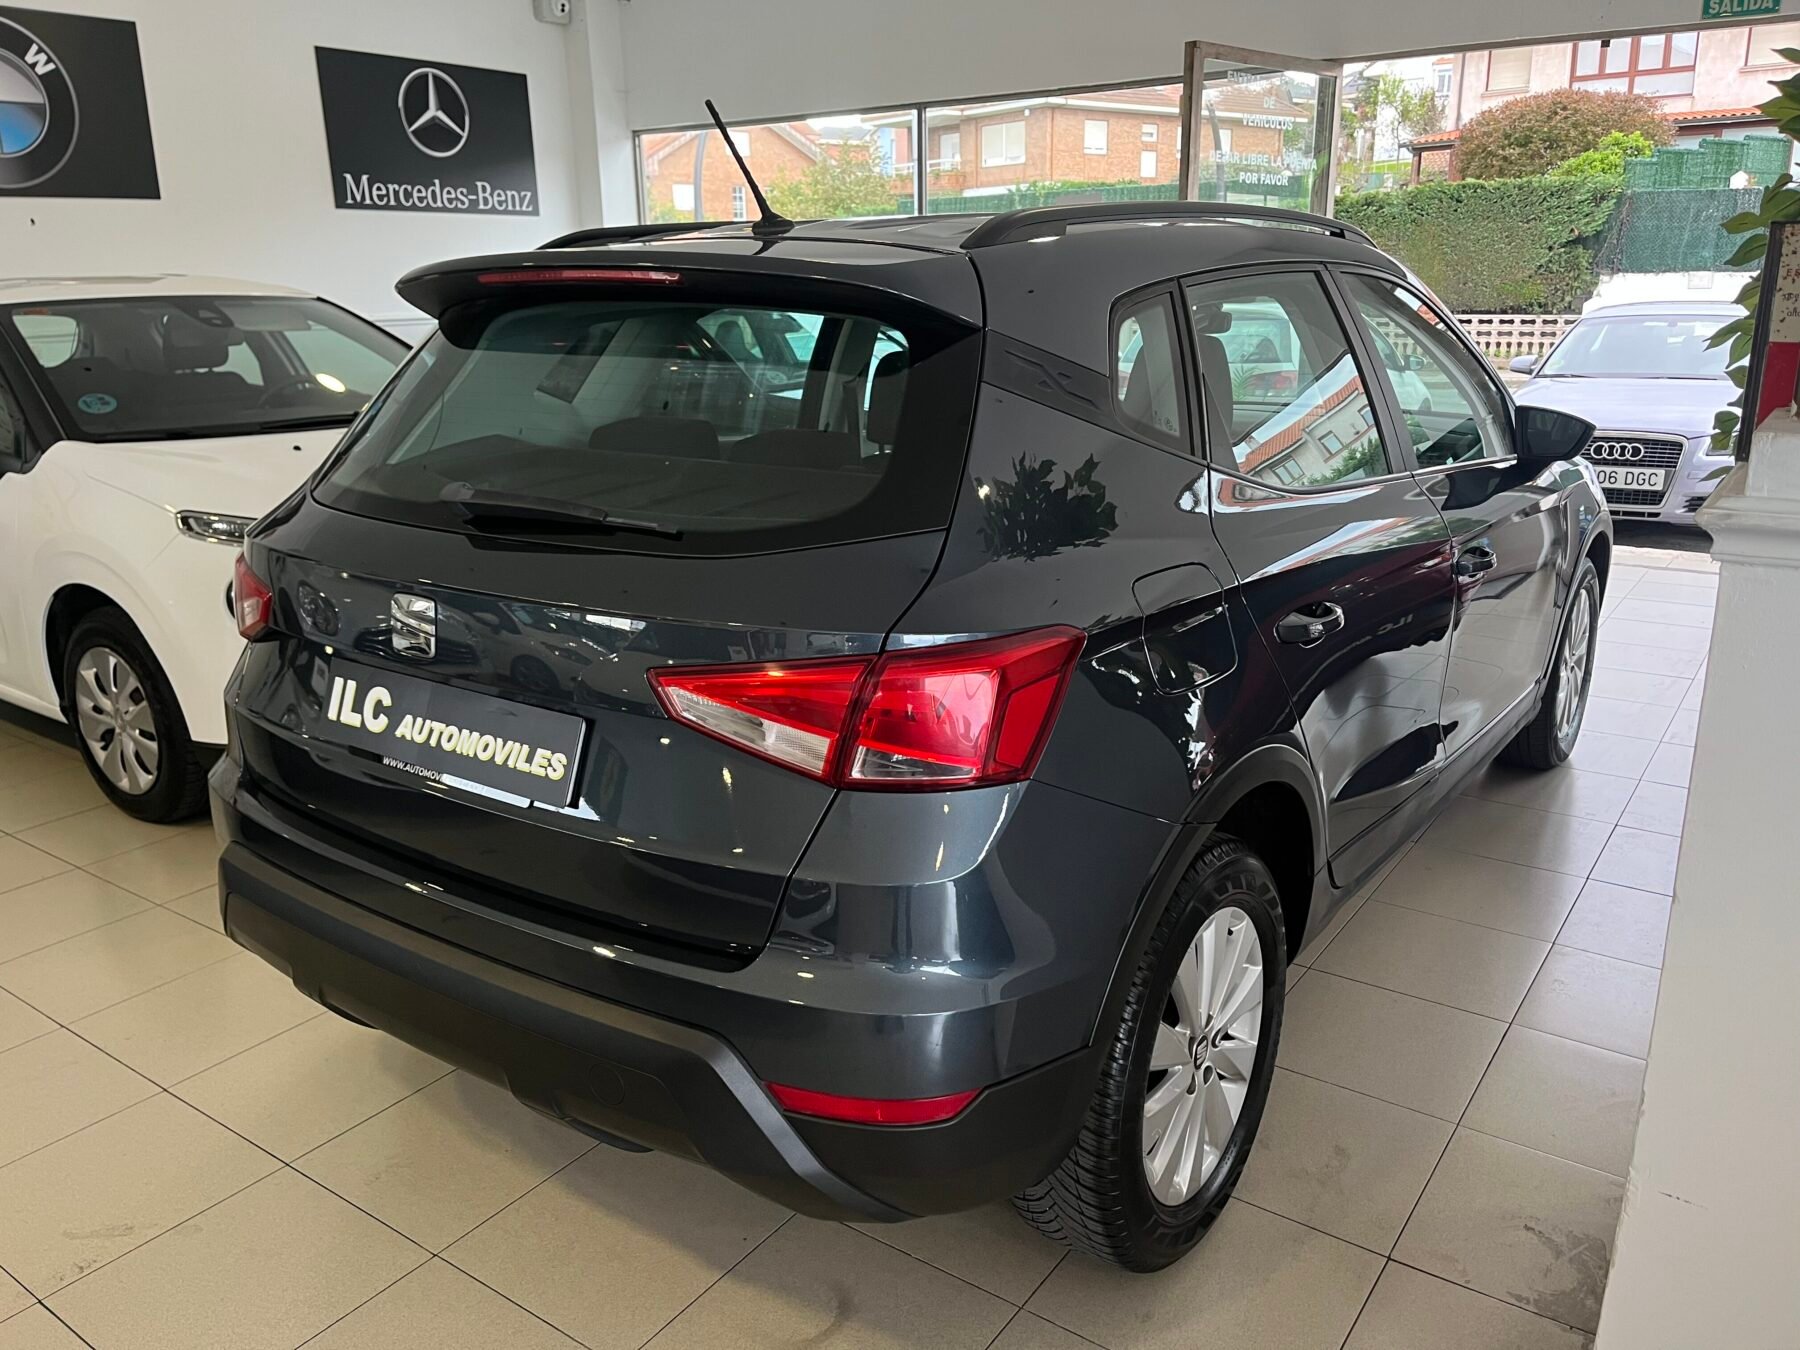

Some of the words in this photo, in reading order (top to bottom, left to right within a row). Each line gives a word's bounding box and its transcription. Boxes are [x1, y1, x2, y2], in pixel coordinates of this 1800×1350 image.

[1708, 0, 1774, 14] SALIDA
[1242, 152, 1269, 167] LIBRE
[1271, 154, 1282, 168] LA
[1239, 172, 1258, 185] POR
[1260, 173, 1289, 187] FAVOR
[343, 172, 534, 213] Mercedes-Benz
[1595, 470, 1618, 485] 06
[1624, 471, 1658, 487] DGC
[326, 676, 393, 734] ILC
[395, 714, 568, 782] AUTOMOVILES
